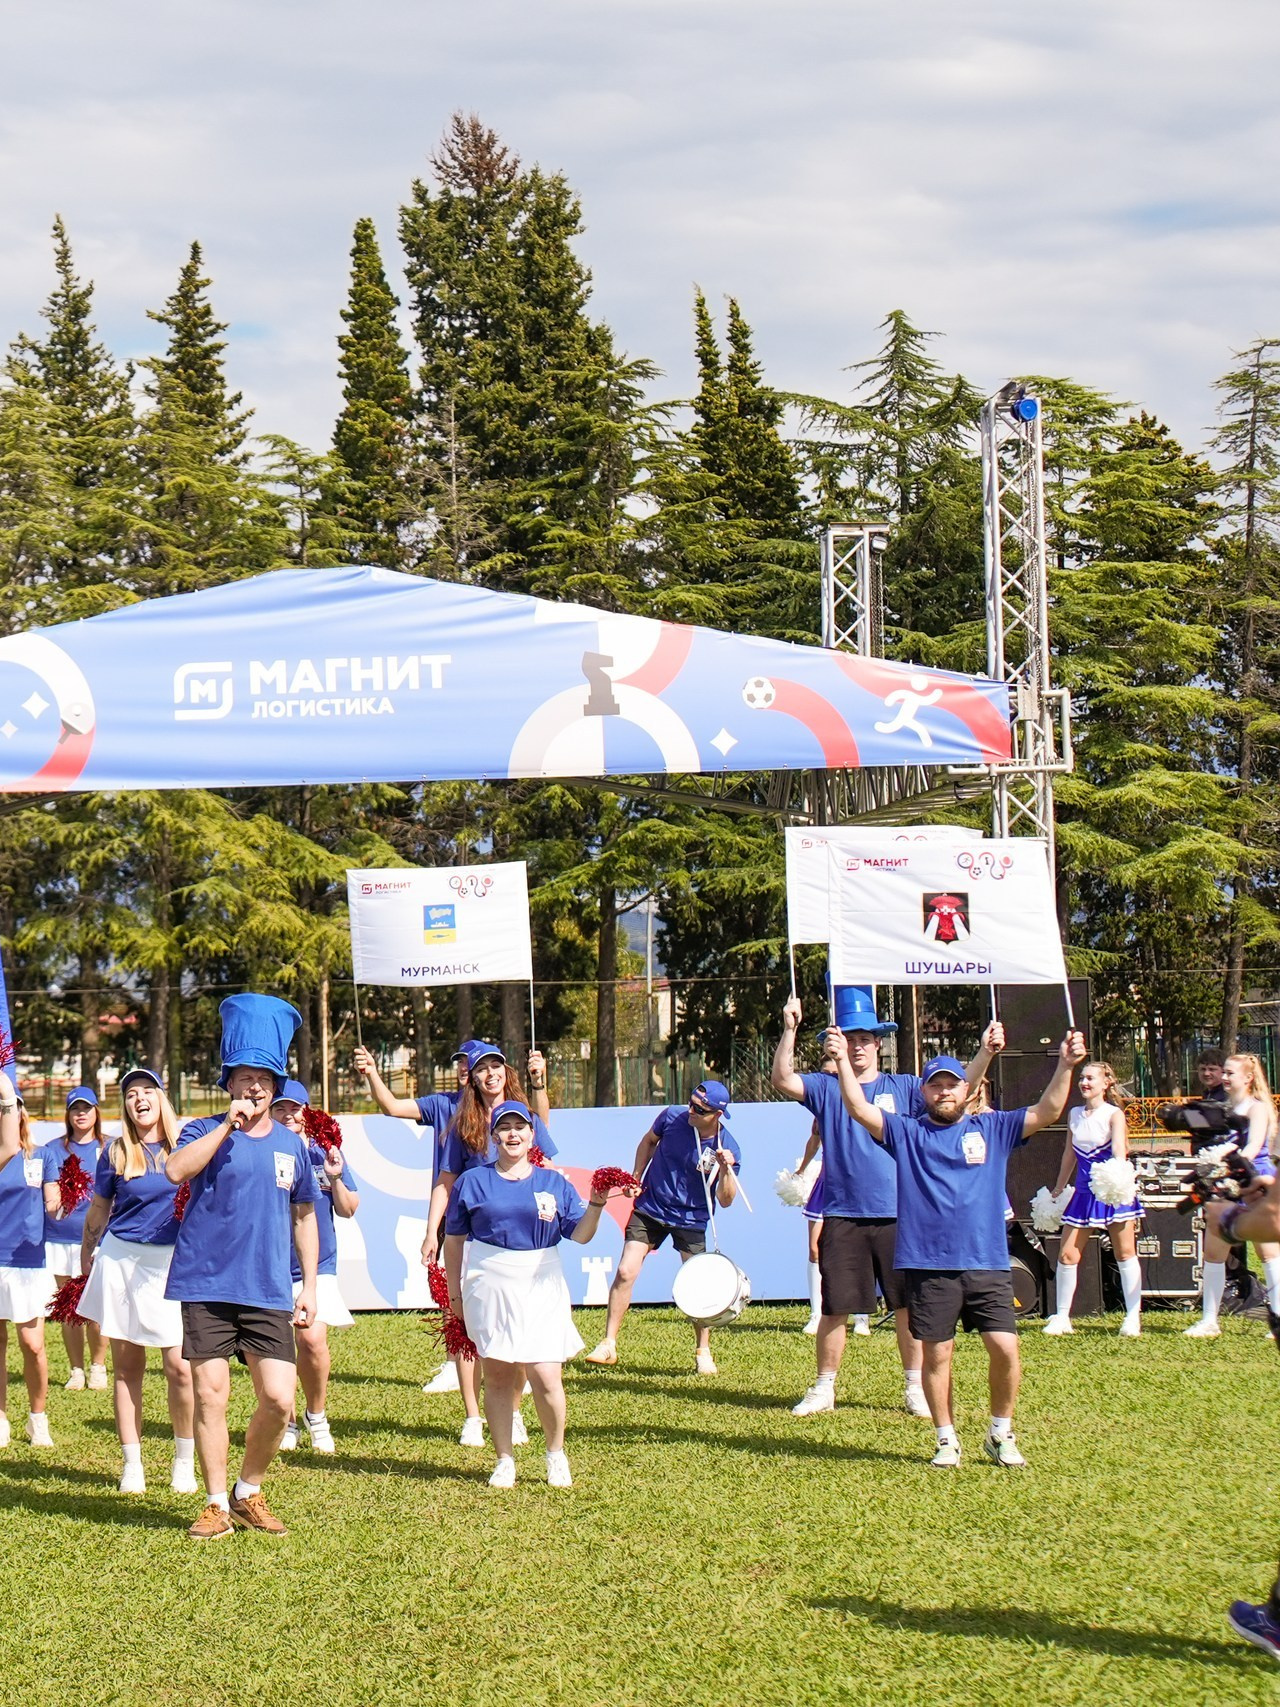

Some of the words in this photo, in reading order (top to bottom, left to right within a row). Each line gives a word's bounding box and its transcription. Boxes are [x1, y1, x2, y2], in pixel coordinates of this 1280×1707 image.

[249, 654, 452, 695] МАГНИТ
[251, 697, 395, 718] ЛОГИСТИКА
[863, 858, 909, 868] МАГНИТ
[374, 881, 412, 890] МАГНИТ
[401, 963, 480, 977] МУРМАНСК
[905, 962, 992, 974] ШУШАРЫ
